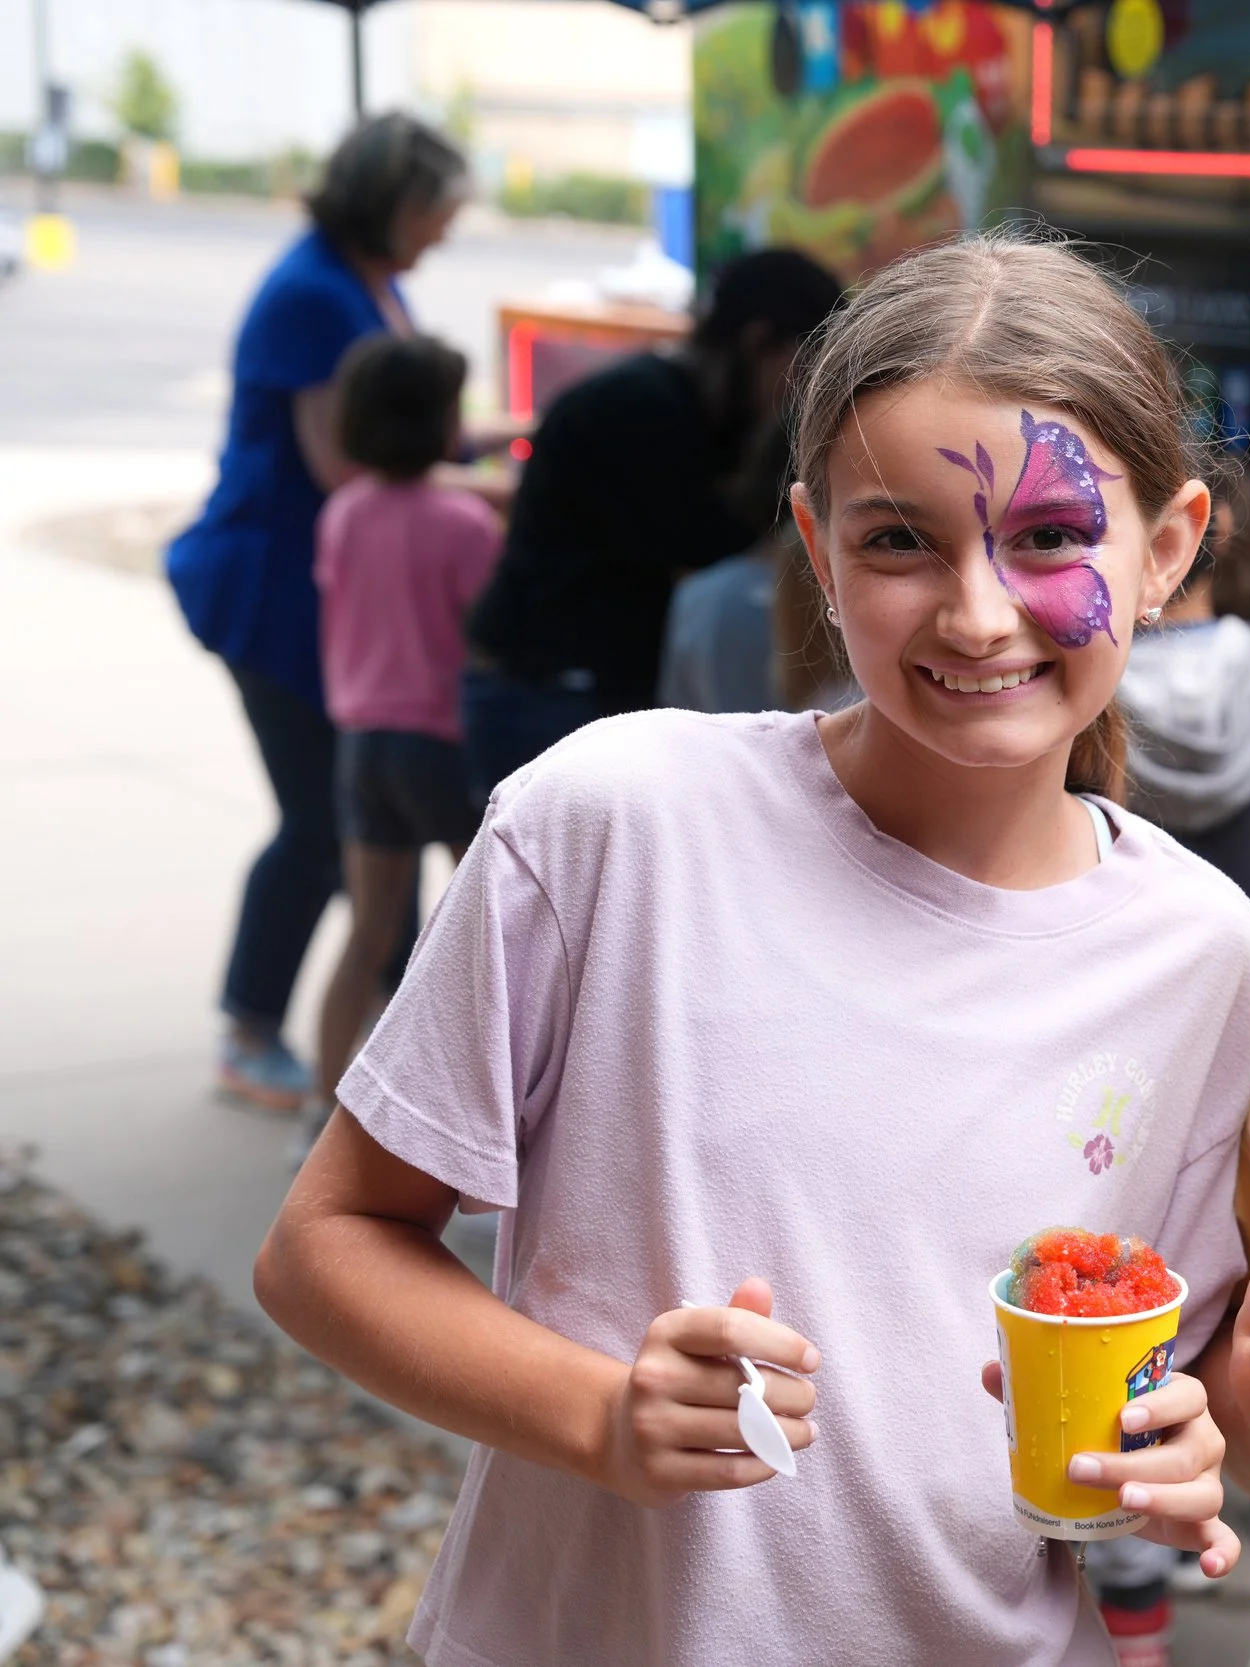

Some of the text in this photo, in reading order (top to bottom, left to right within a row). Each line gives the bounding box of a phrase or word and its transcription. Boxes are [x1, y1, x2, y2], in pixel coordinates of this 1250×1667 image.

[1055, 1052, 1118, 1122] HURLEY
[1024, 1509, 1061, 1527] FUNdraisers!
[1074, 1521, 1095, 1530] Book
[1096, 1520, 1114, 1529] Kona
[1115, 1518, 1125, 1526] for
